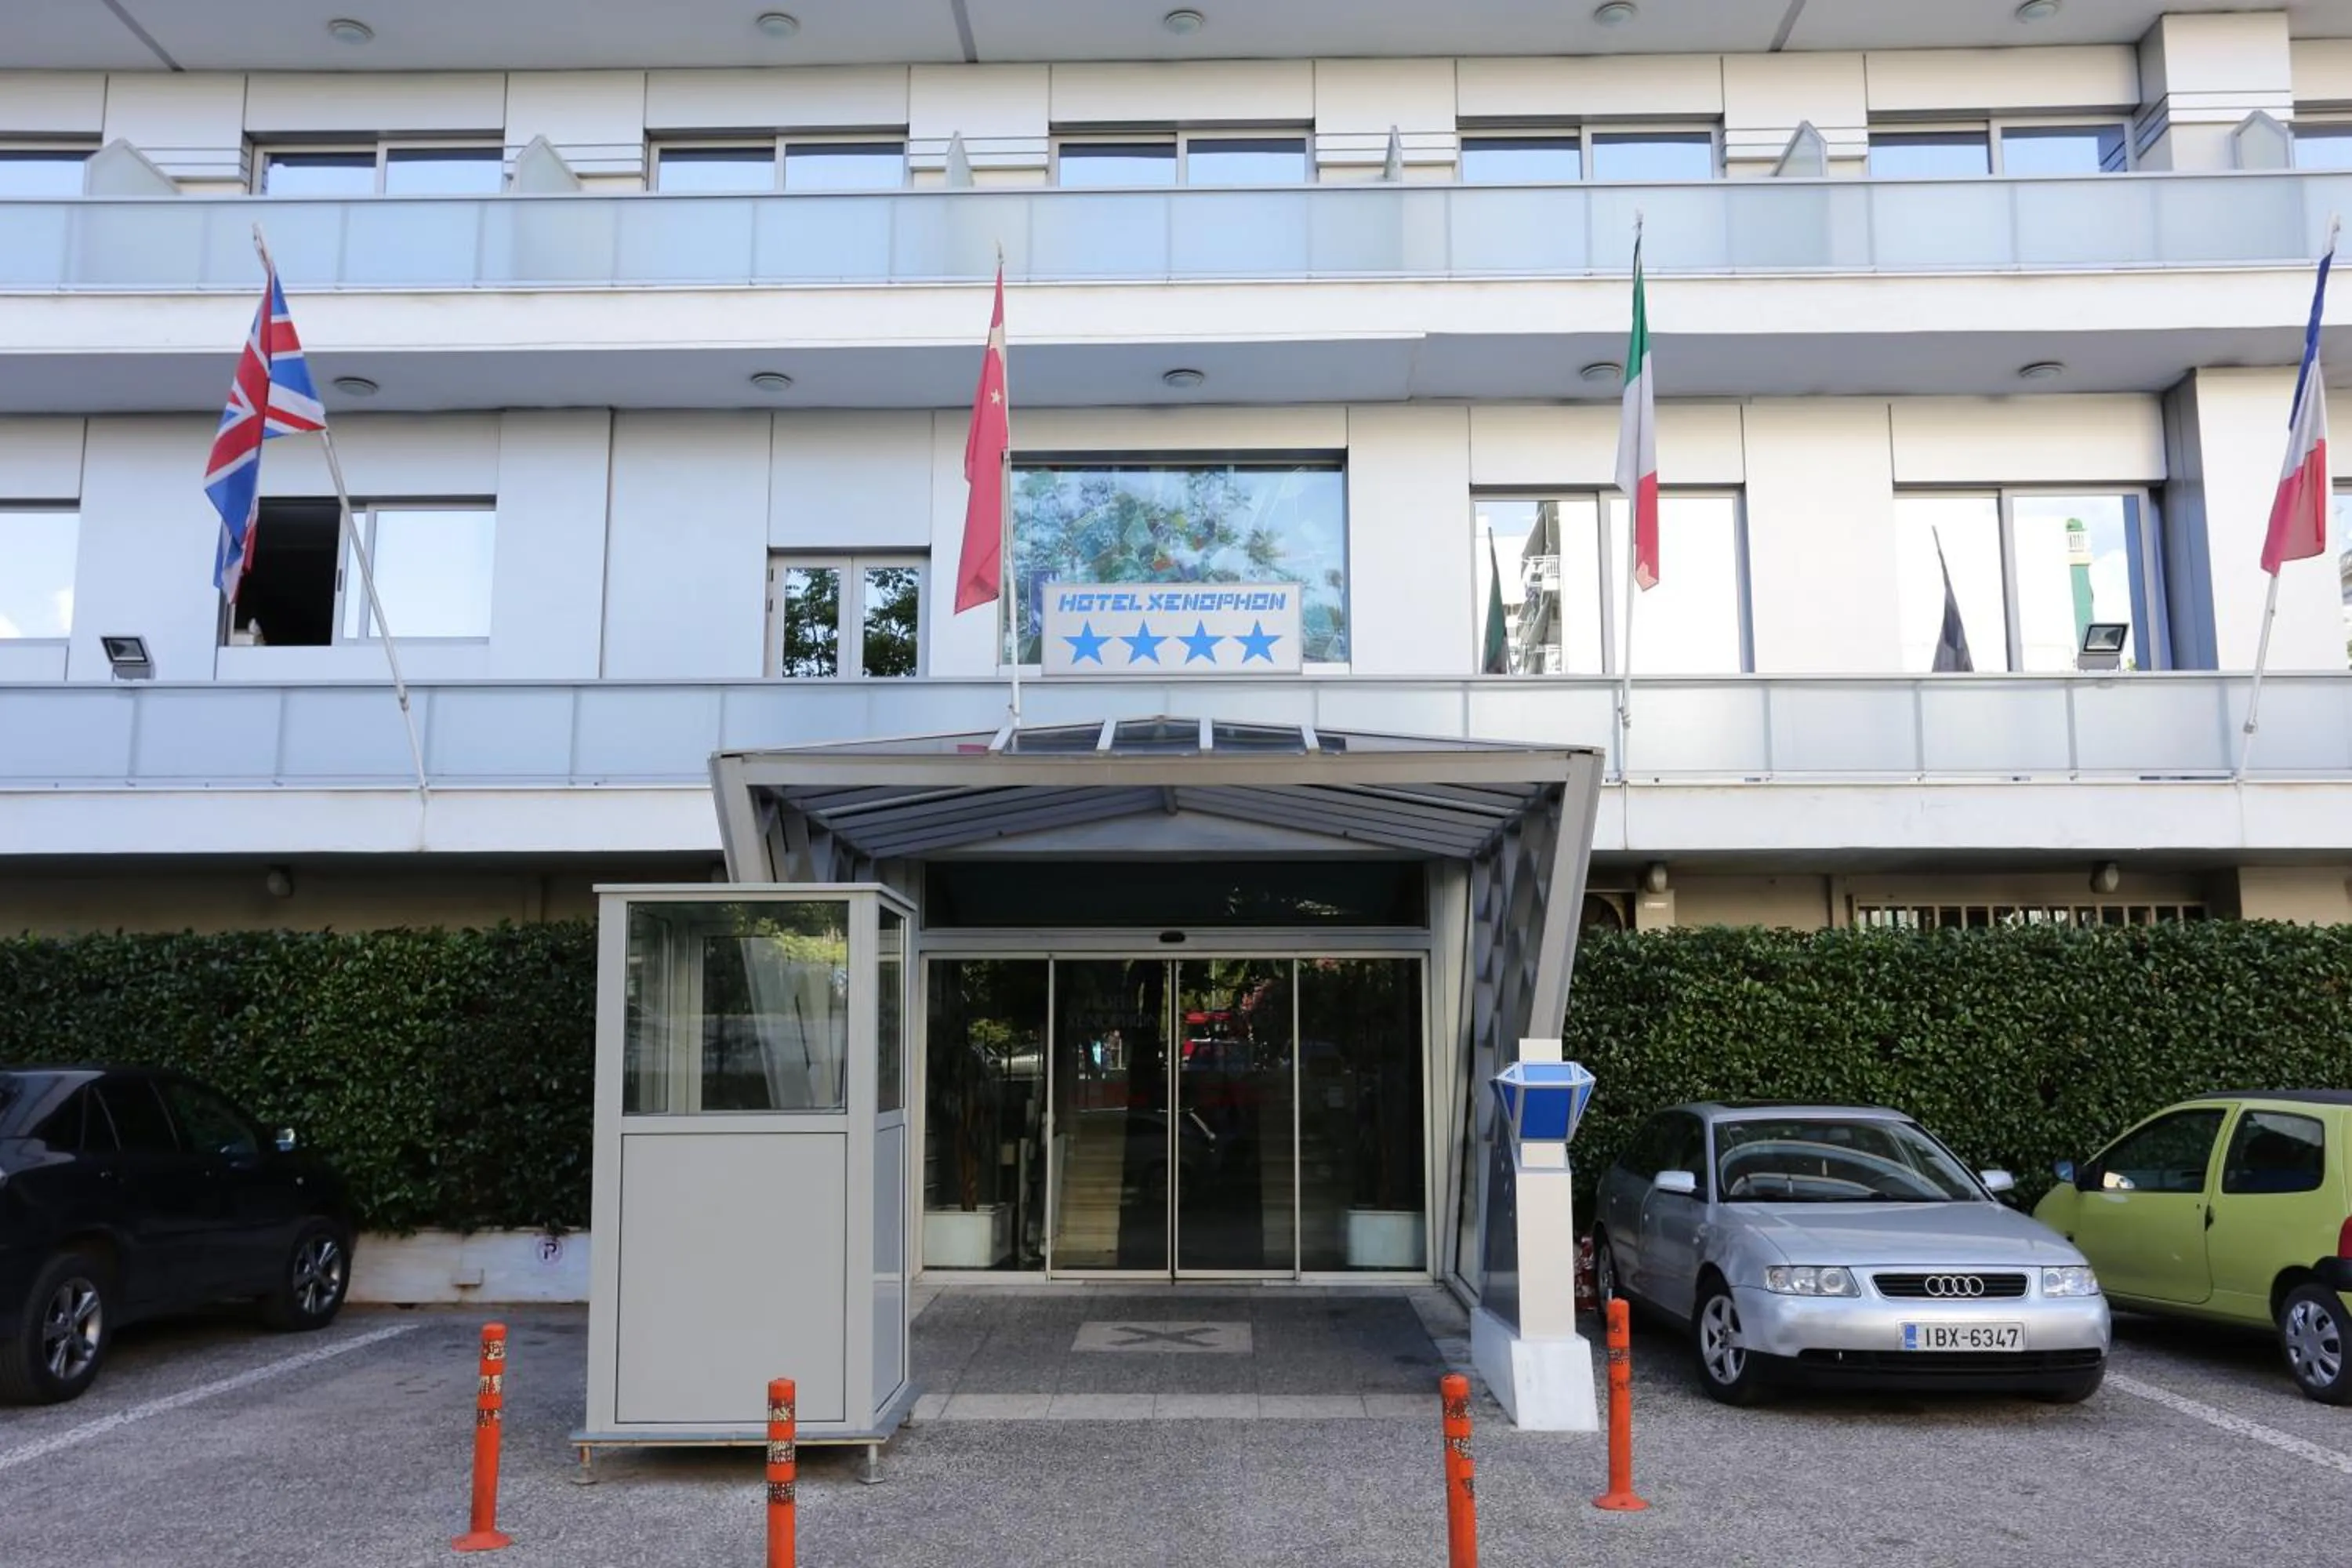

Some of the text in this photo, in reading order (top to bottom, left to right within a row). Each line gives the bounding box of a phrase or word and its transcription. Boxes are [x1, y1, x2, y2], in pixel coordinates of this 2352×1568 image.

[1058, 593, 1286, 612] HOTEL XENOPHON
[1926, 1328, 2018, 1347] IBX-6347
